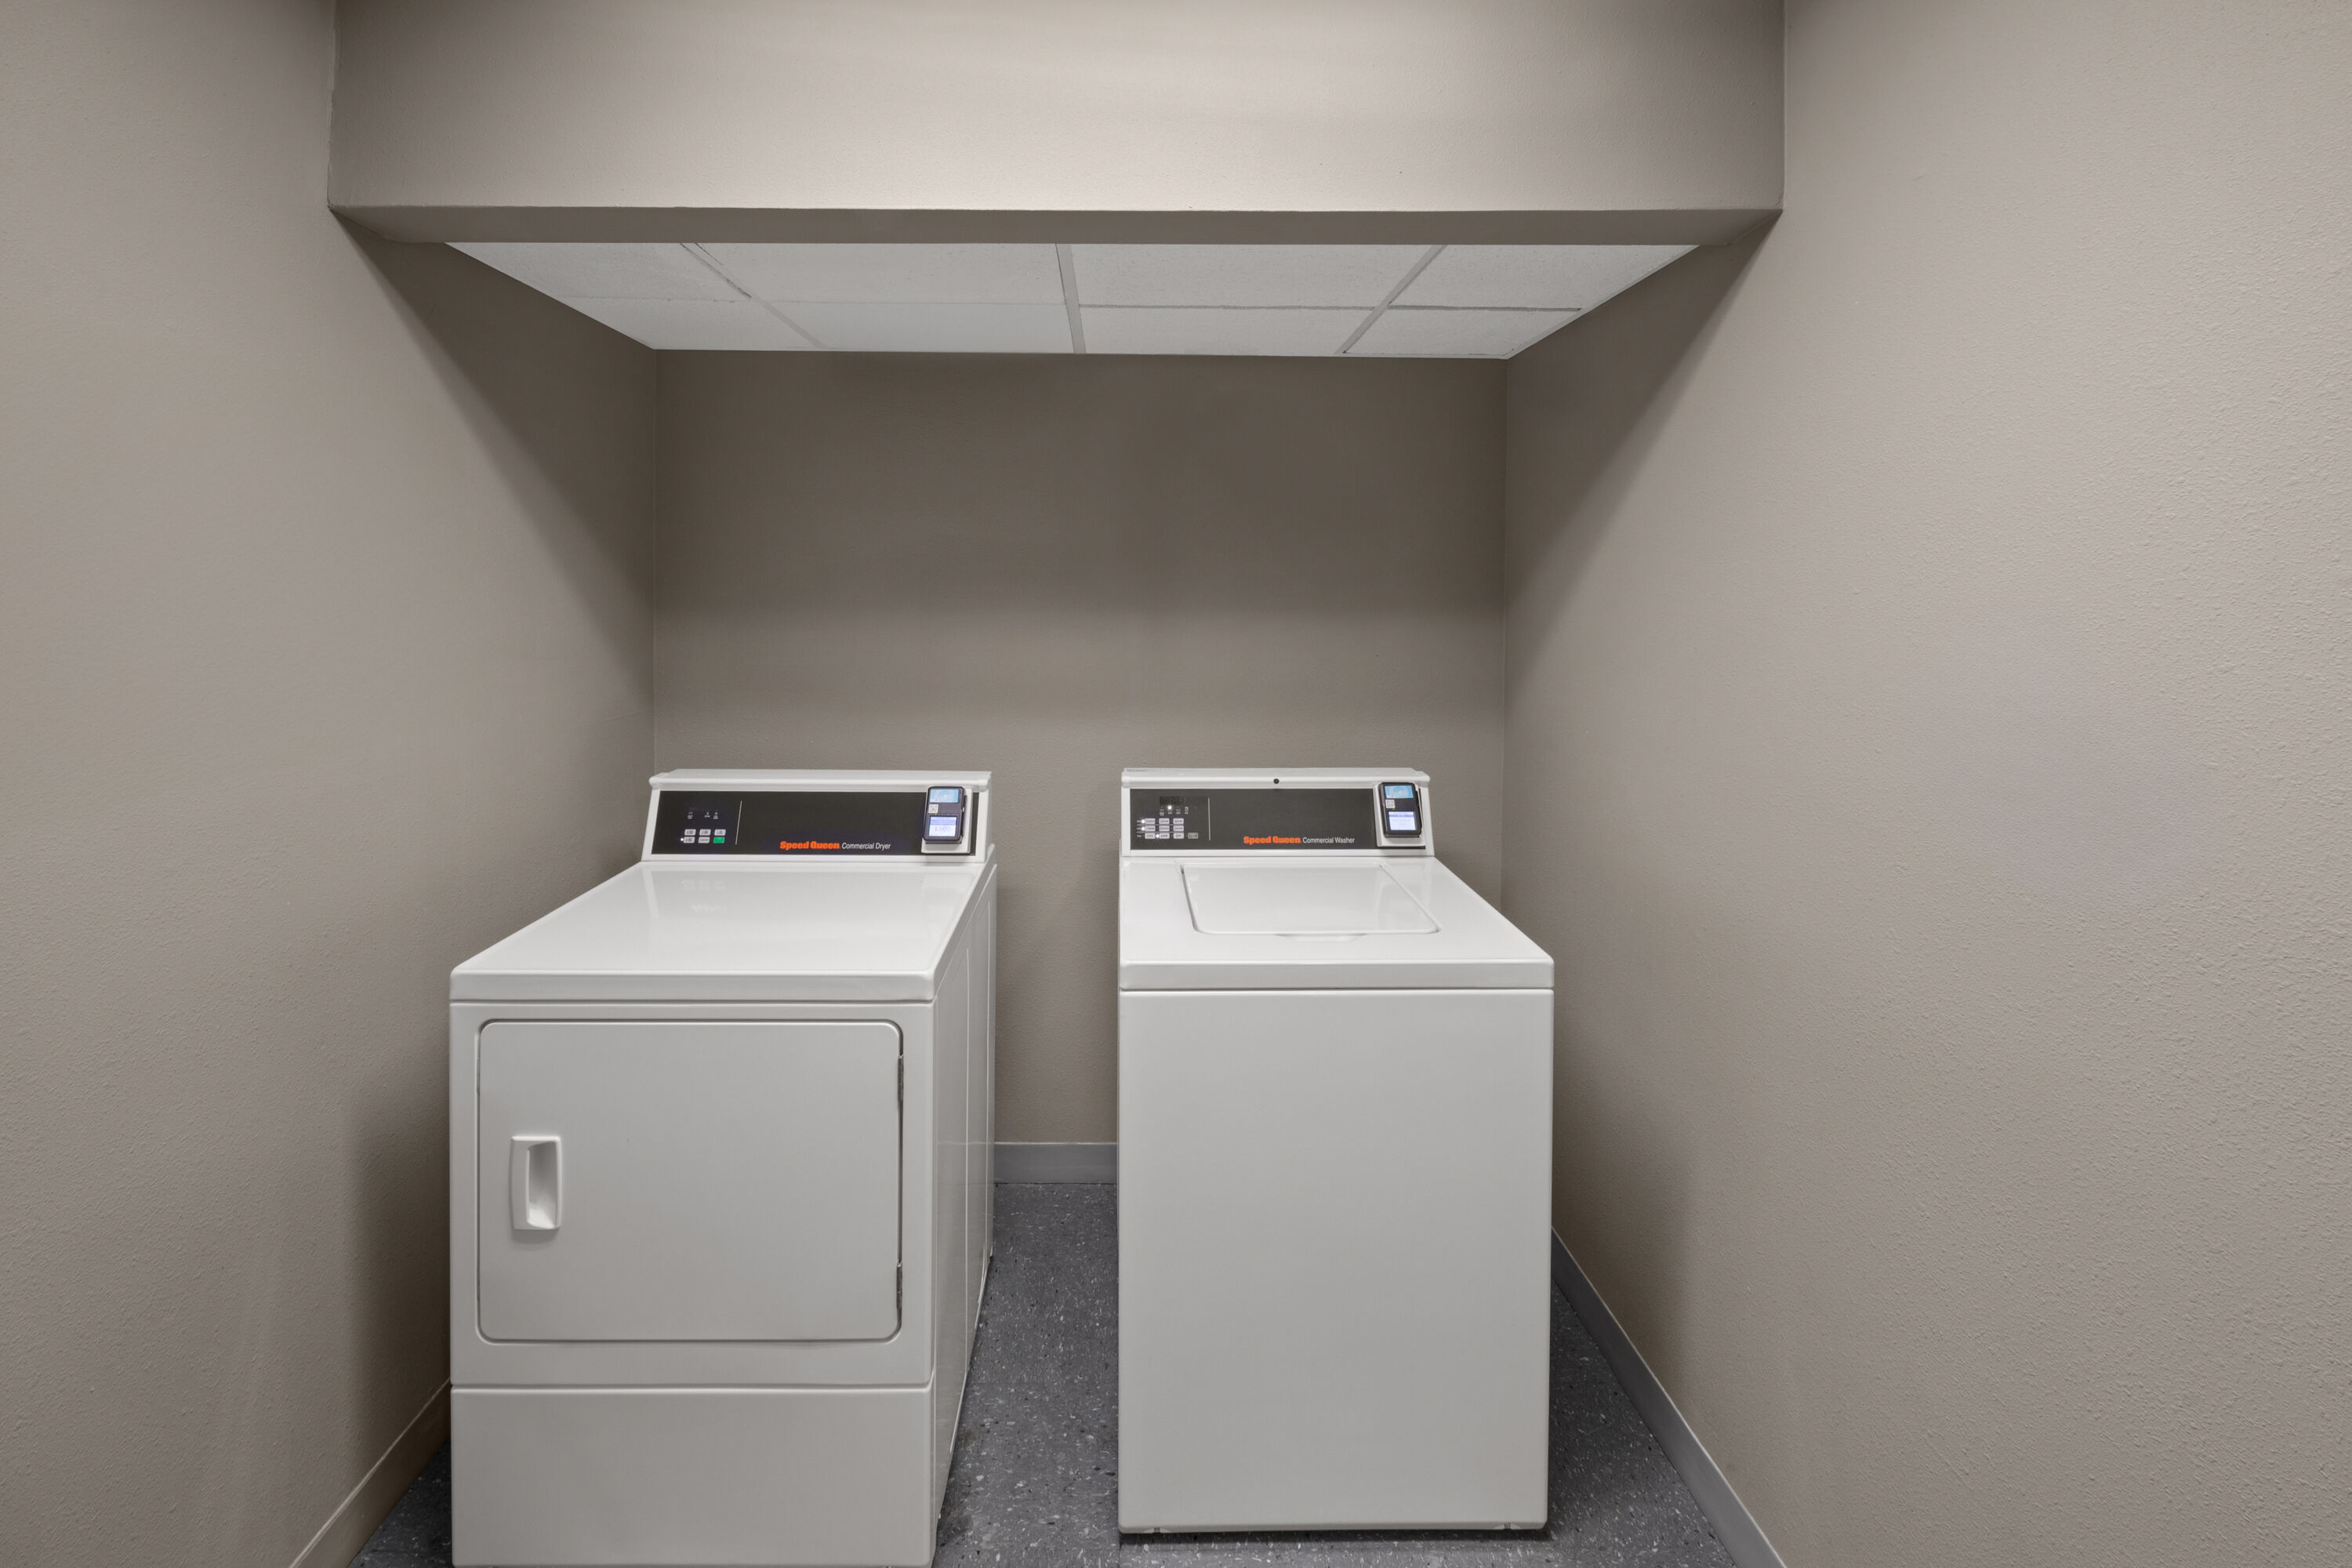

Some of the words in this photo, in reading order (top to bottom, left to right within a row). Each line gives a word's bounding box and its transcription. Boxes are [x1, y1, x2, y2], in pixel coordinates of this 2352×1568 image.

[779, 840, 810, 851] Speed
[810, 840, 840, 849] Queen
[875, 842, 891, 851] Dryer
[1243, 836, 1272, 845] Speed
